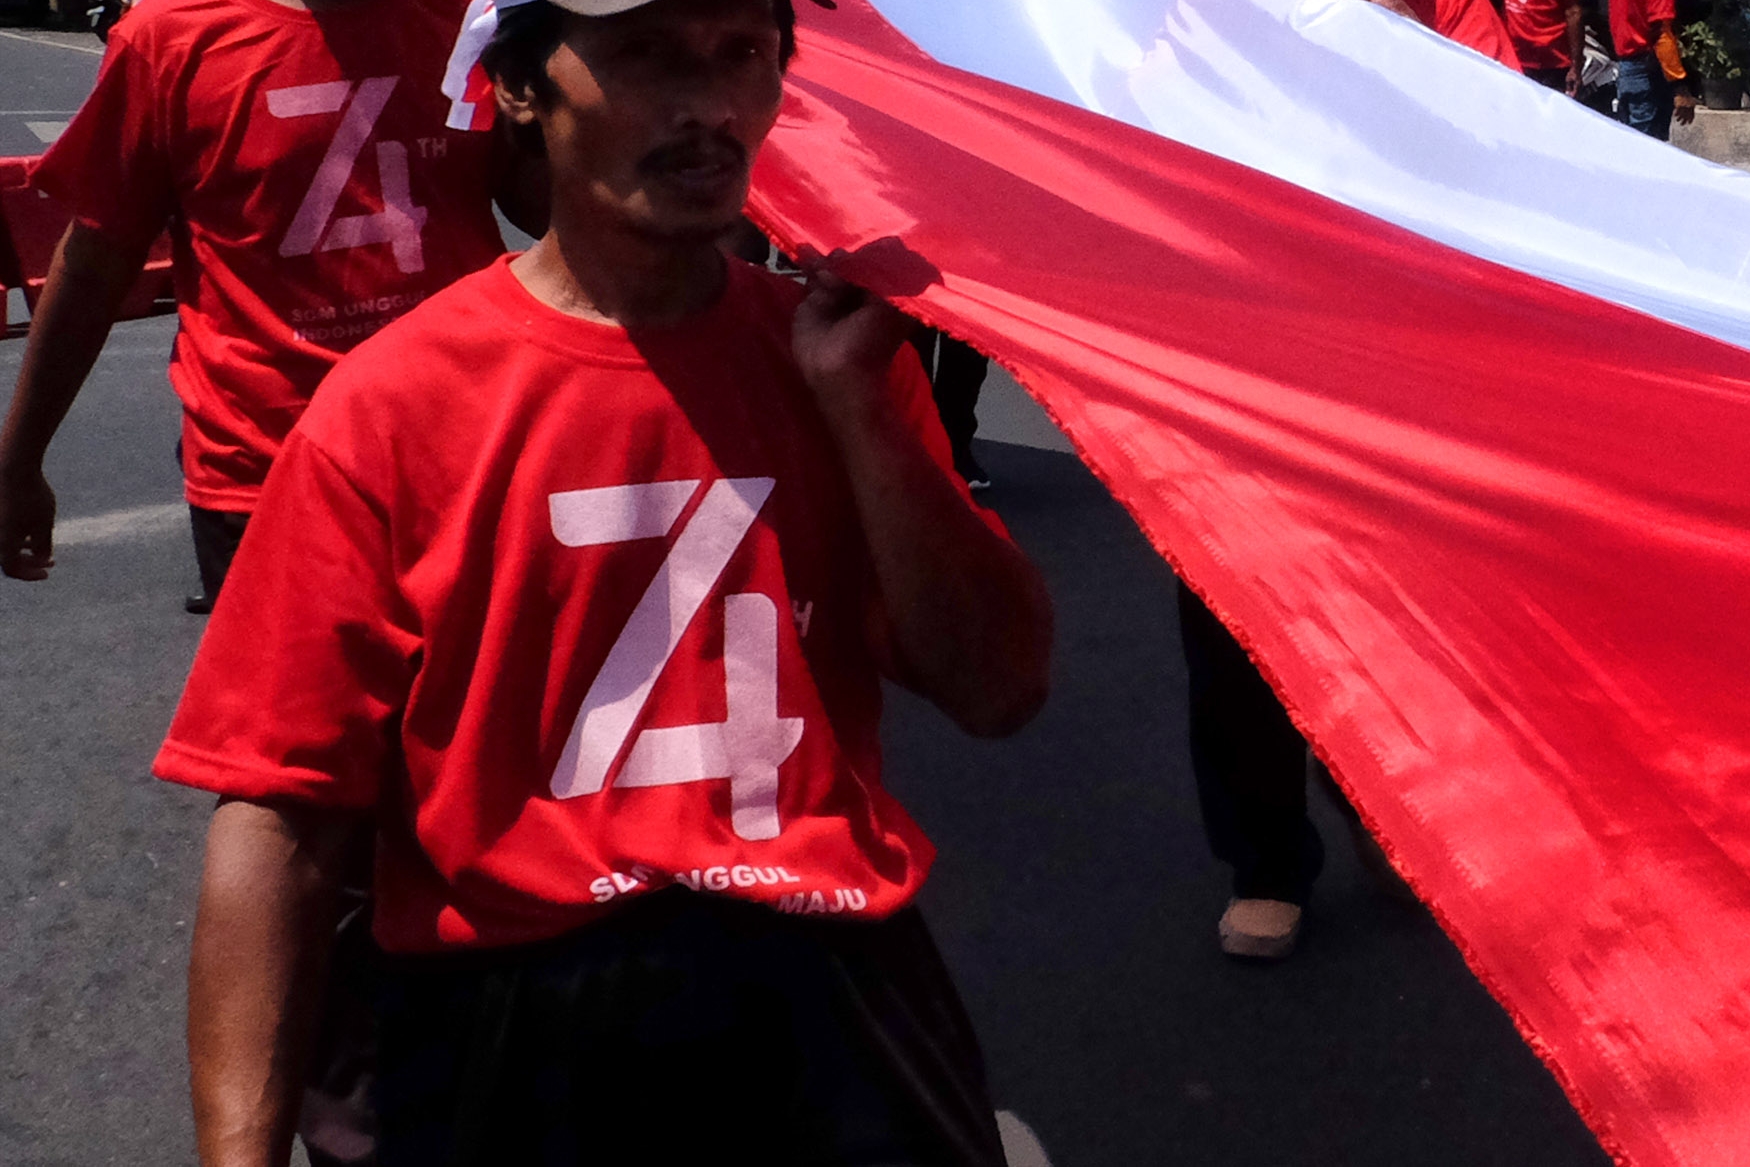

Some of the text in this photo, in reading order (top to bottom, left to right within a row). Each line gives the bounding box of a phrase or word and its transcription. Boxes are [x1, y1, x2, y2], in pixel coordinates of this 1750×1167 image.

[265, 75, 428, 274] 74
[549, 477, 804, 841] 74
[776, 888, 867, 914] MAJU
